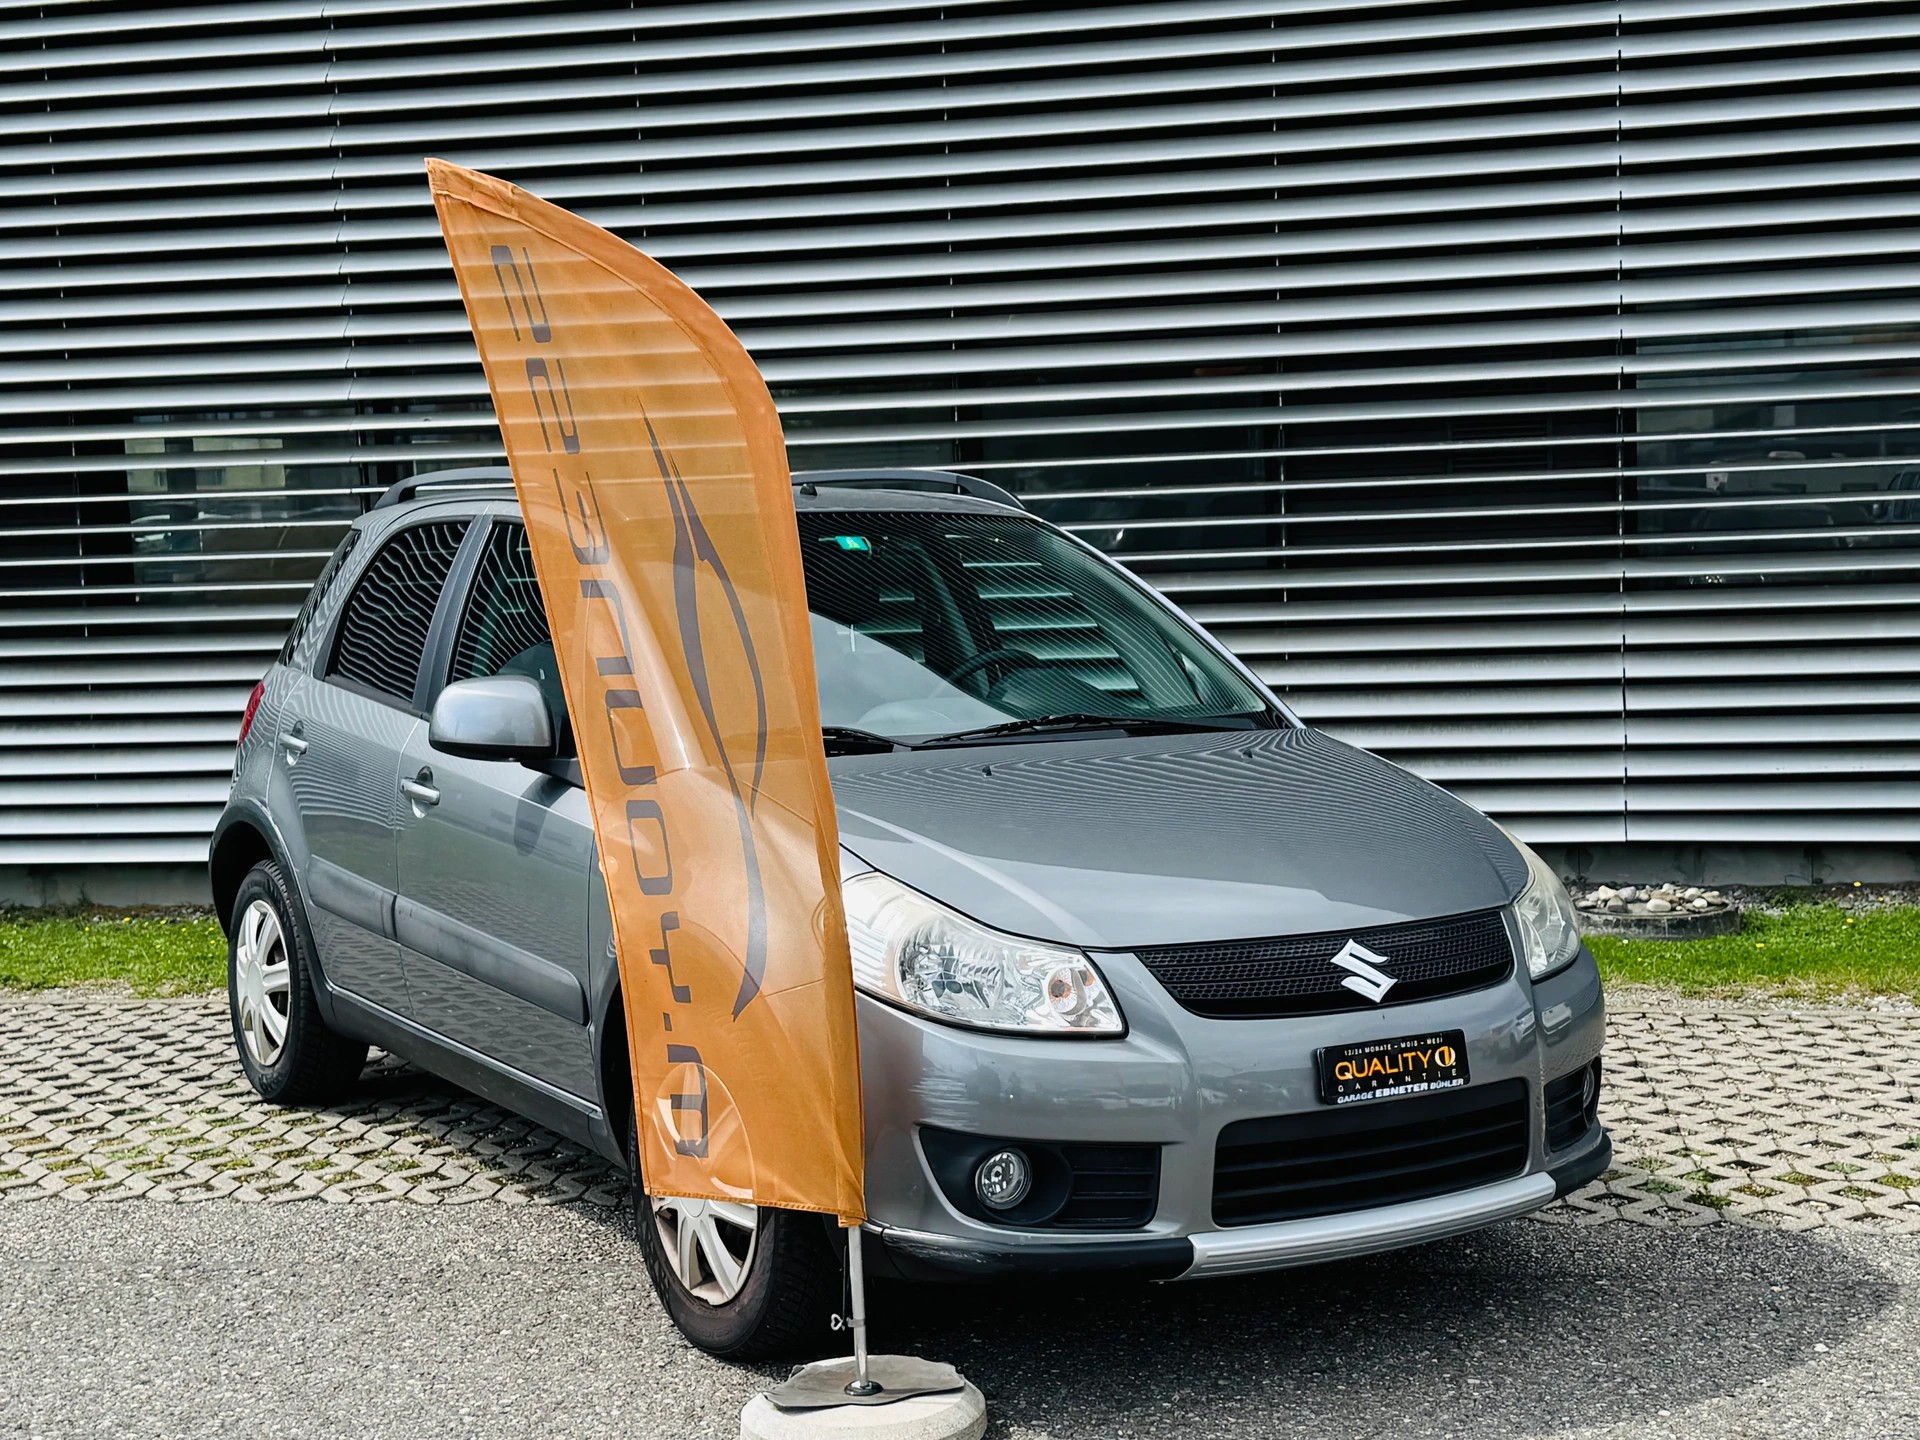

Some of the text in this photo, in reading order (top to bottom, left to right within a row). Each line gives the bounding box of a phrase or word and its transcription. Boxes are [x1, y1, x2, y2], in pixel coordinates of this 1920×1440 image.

[1335, 1049, 1432, 1080] QUALITY
[1338, 1069, 1457, 1092] GARANTIE
[1337, 1091, 1373, 1104] GARAGE
[1375, 1082, 1428, 1097] EBNETER
